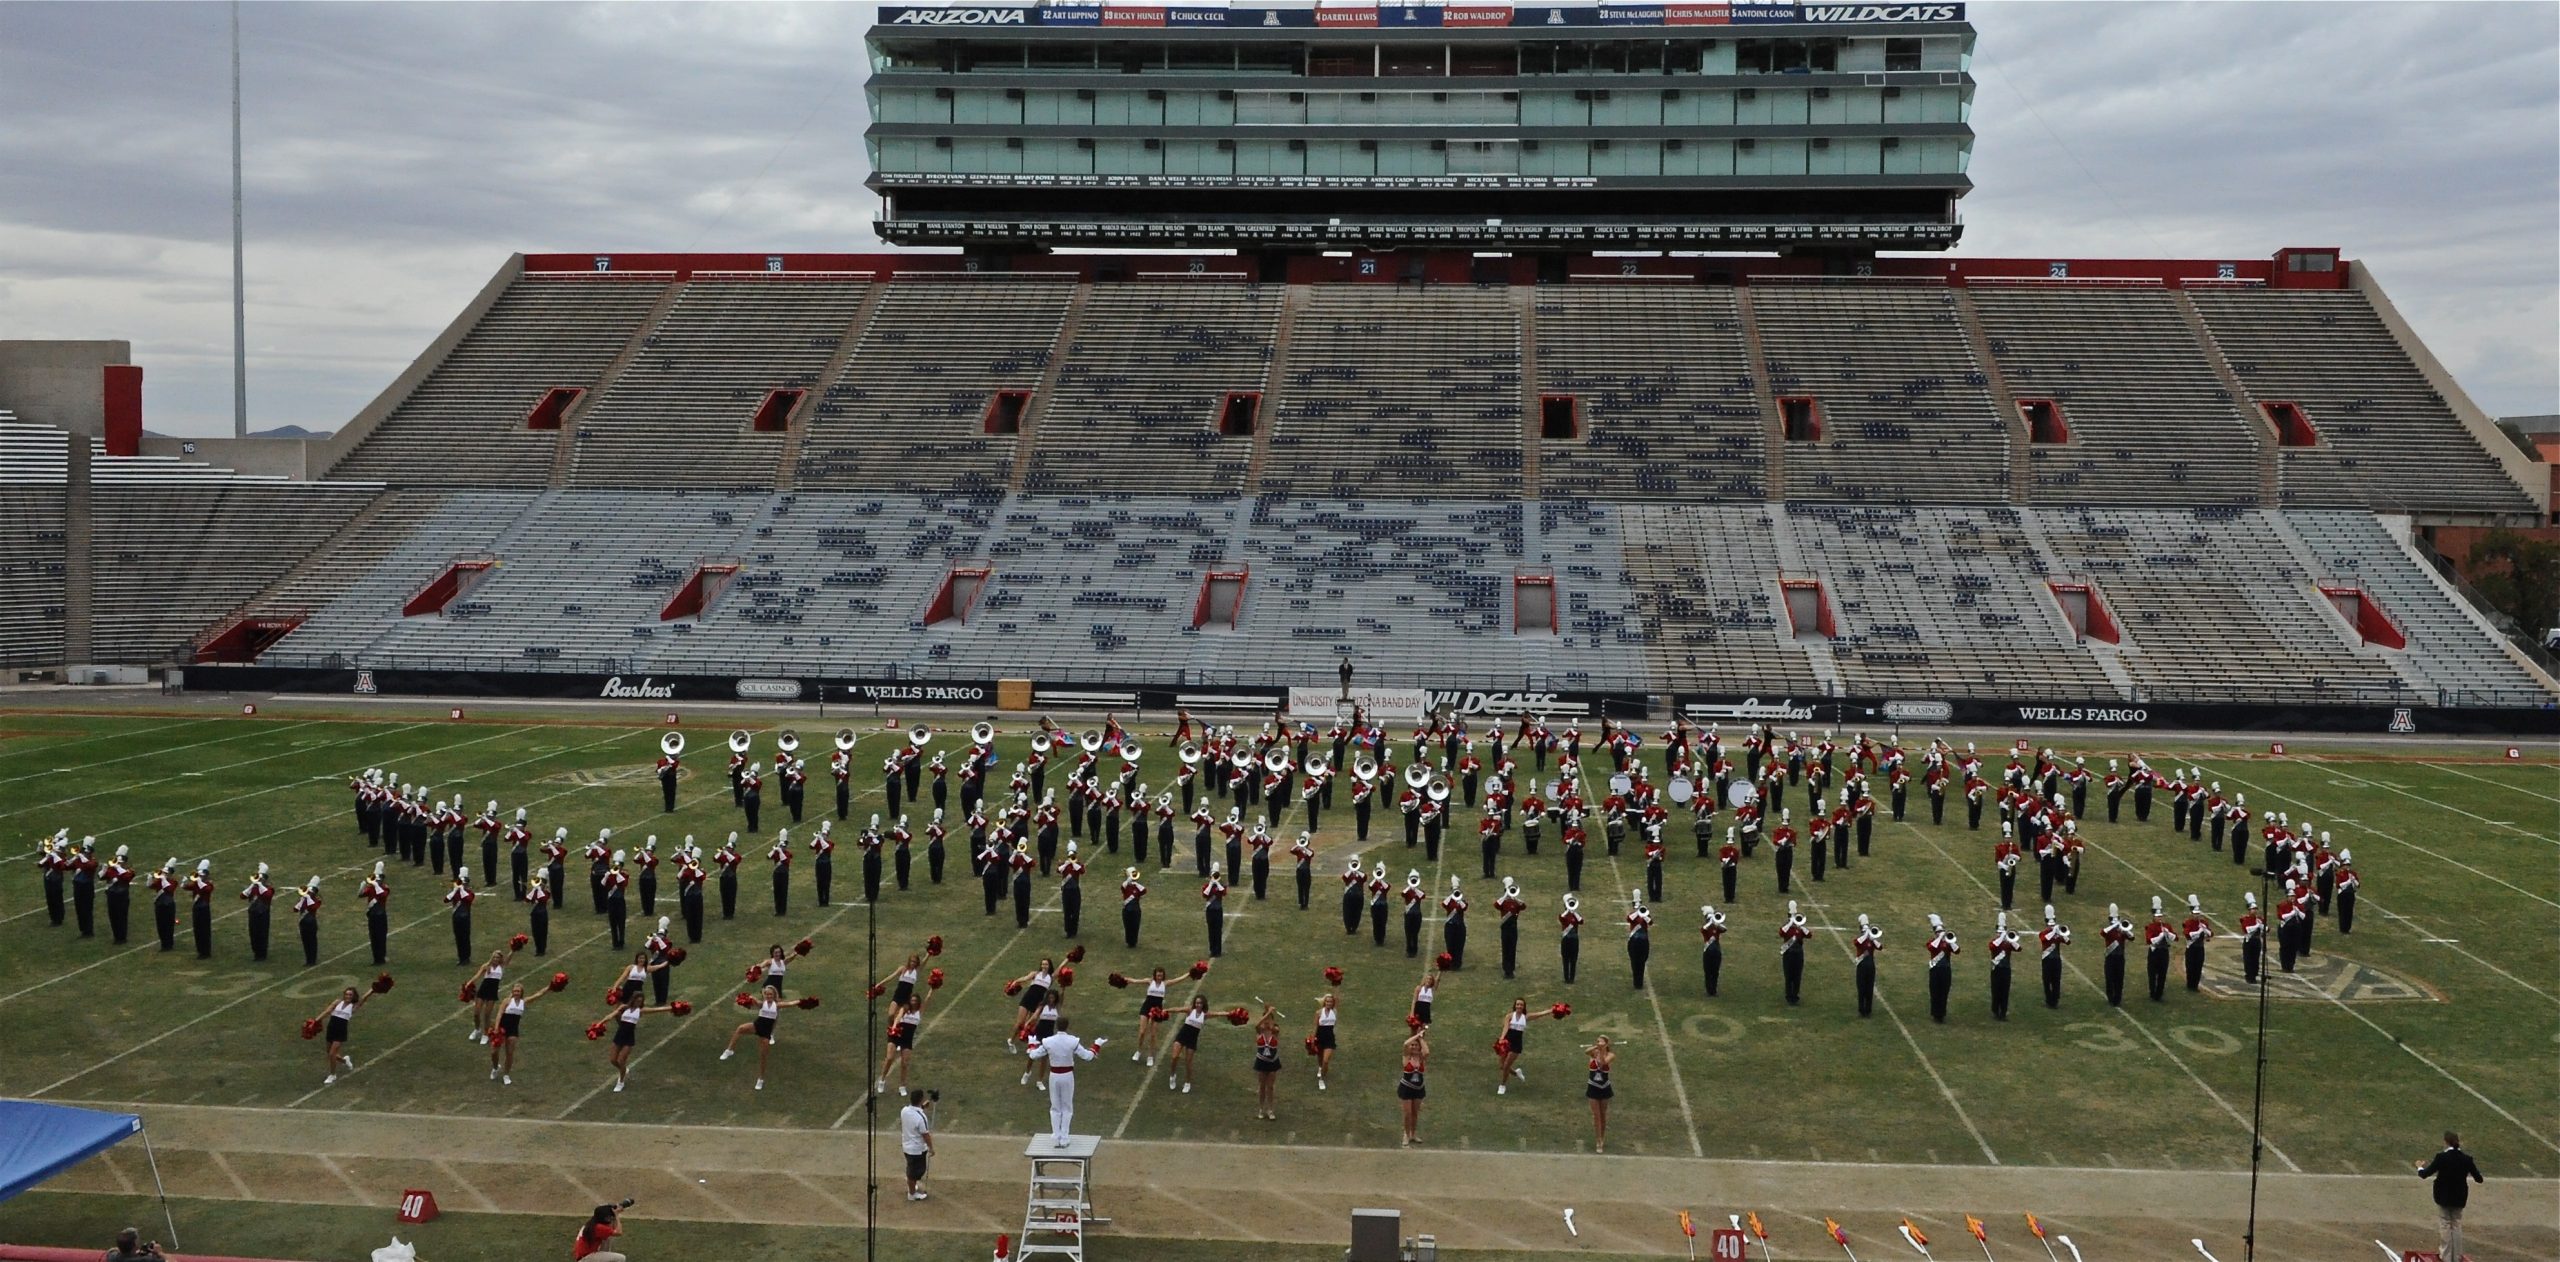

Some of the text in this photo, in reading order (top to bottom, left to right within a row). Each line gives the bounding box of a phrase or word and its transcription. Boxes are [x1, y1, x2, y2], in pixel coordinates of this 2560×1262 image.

[894, 10, 1024, 24] ARIZONA
[1042, 10, 1051, 19] 22
[1104, 12, 1164, 20] 89 RICKY HUNLEY
[1171, 12, 1176, 20] 6
[1177, 12, 1203, 20] CHUCK
[1443, 12, 1506, 20] 92 ROB WALDROP
[1600, 10, 1664, 18] 28 STEVE McLAUGHLIN
[1665, 9, 1729, 18] 11 CHRIS McALISTER
[1732, 9, 1794, 17] 5 ANTOINE CASON
[1805, 6, 1956, 21] WILDCATS
[596, 262, 608, 271] 17
[768, 262, 781, 271] 18
[966, 262, 978, 272] 19
[1190, 264, 1204, 273] 20
[1362, 264, 1374, 273] 21
[1622, 265, 1636, 275] 22
[1857, 266, 1871, 276] 23
[2051, 268, 2066, 278] 24
[2219, 269, 2234, 278] 25
[183, 444, 194, 452] 16
[600, 677, 675, 698] Bashas'
[742, 684, 795, 692] SOL CASINOS
[863, 686, 983, 699] WELLS FARGO
[1293, 696, 1334, 706] UNIVERSITY
[1382, 697, 1403, 707] BAND
[1405, 698, 1420, 708] DAY
[1889, 706, 1946, 714] SOL CASINOS
[2019, 707, 2147, 721] WELLS FARGO
[2274, 745, 2283, 753] 10
[2509, 749, 2519, 758] G
[2064, 1023, 2242, 1054] 30
[402, 1194, 423, 1218] 40
[1717, 1235, 1739, 1259] 40
